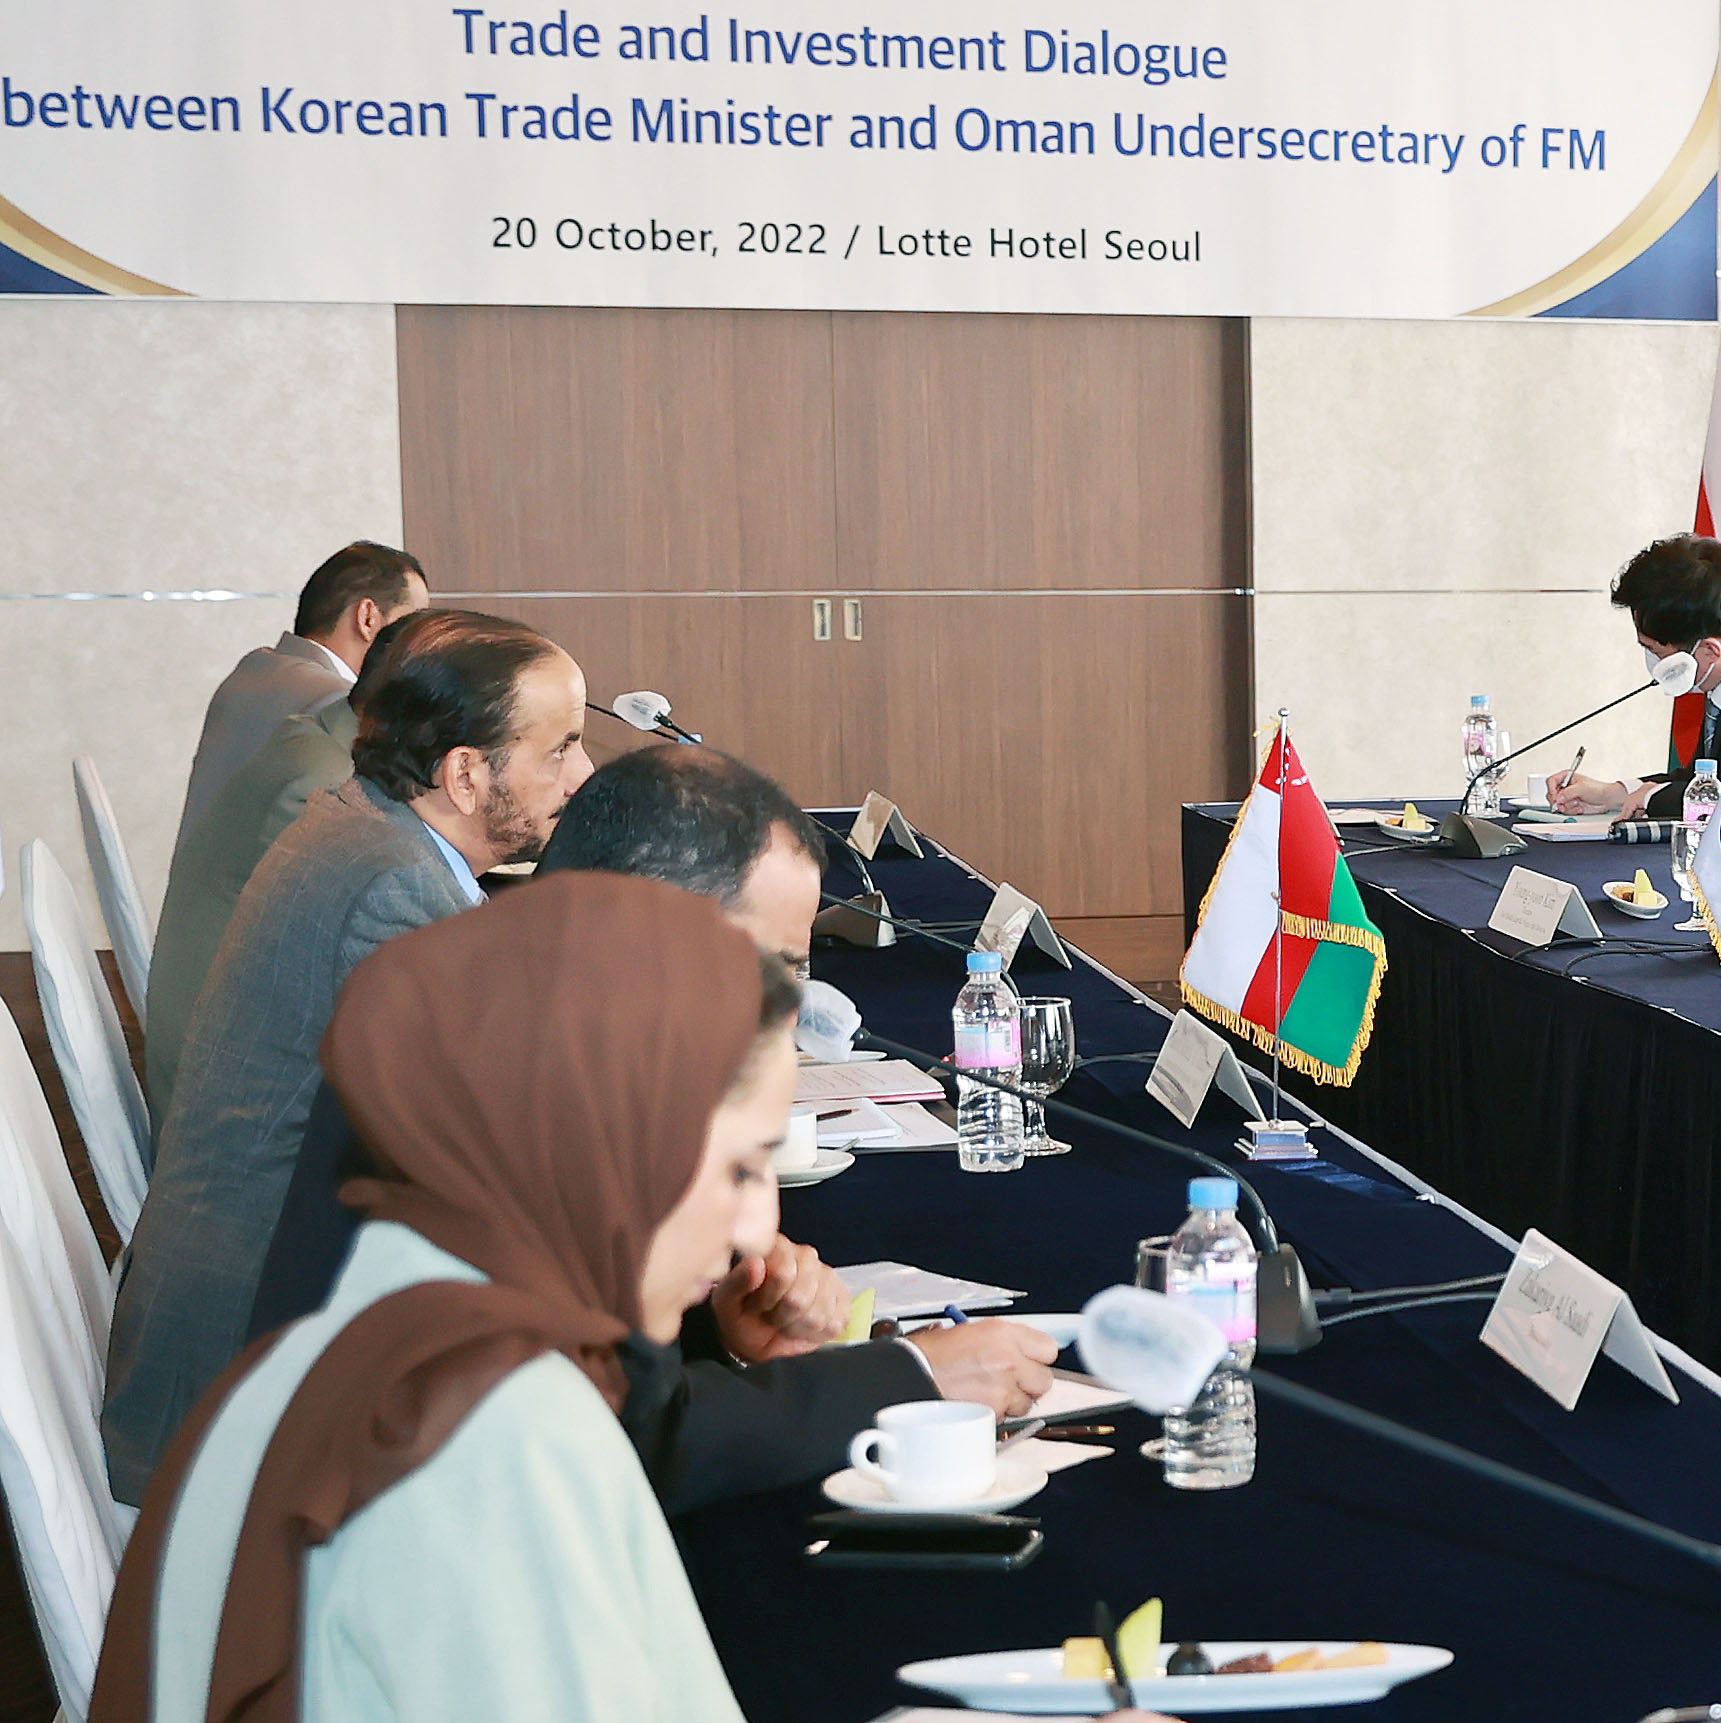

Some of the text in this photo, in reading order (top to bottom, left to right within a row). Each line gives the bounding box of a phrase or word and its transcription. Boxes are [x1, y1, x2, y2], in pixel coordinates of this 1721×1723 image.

[452, 8, 1227, 86] Trade and Investment Dialogue
[1, 76, 1606, 174] between Korean Trade Minister and Oman Undersecretary of FM
[492, 216, 1200, 262] 20 October, 2022 / Lotte Hotel Seoul
